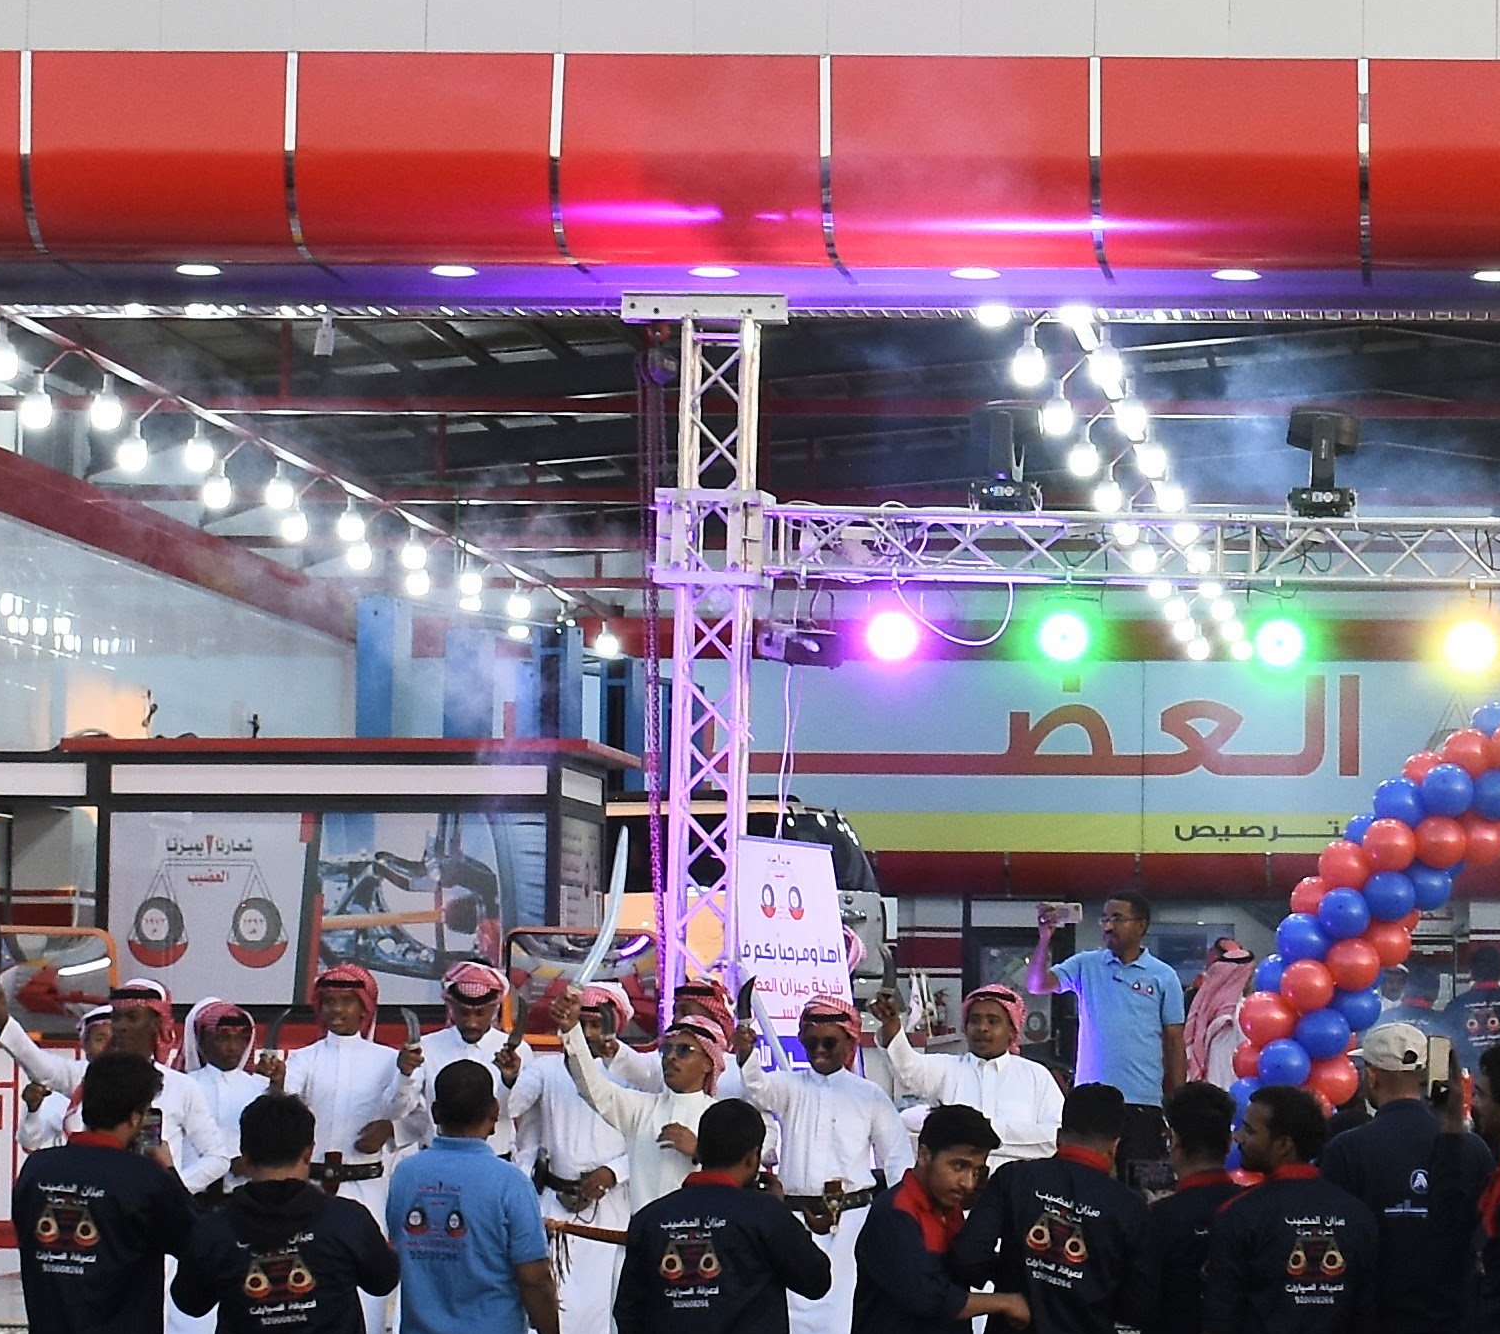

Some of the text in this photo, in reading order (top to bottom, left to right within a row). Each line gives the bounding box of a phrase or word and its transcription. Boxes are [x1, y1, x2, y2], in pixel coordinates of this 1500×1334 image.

[742, 939, 751, 958] ف
[780, 977, 810, 998] ميزان
[812, 976, 844, 996] شركة
